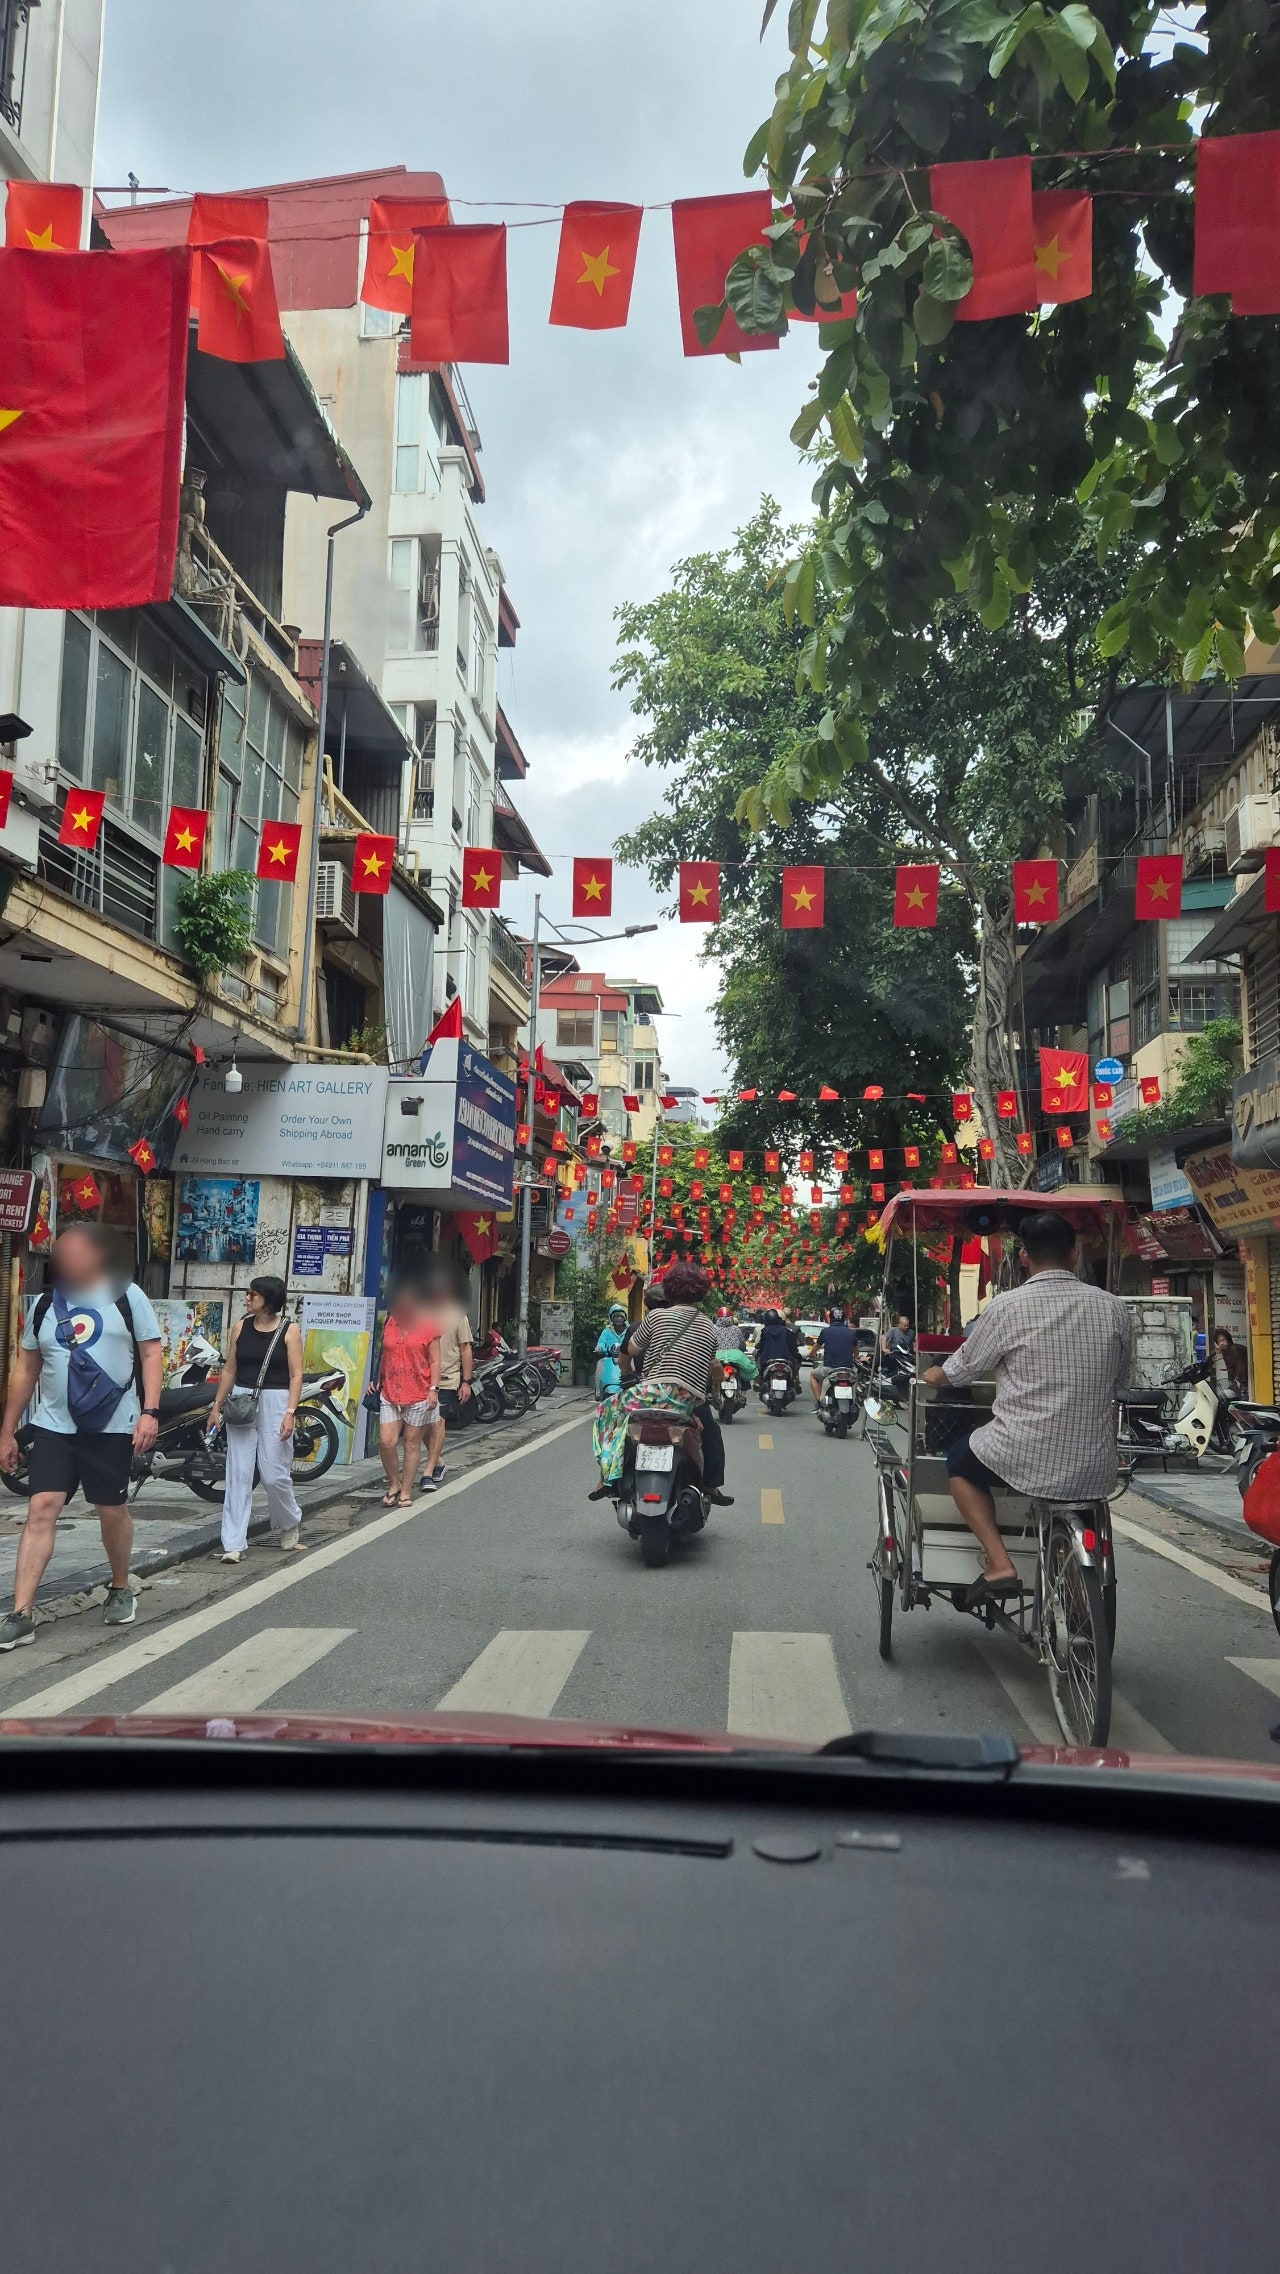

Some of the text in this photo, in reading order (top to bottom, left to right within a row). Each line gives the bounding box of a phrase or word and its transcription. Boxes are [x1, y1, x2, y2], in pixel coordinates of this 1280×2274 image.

[204, 1078, 372, 1094] Fane: HIEN ART GALLERY
[198, 1111, 249, 1124] Oil Painting
[280, 1114, 352, 1125] Order Your Own
[197, 1126, 245, 1138] Hand carry
[280, 1128, 353, 1140] Shipping Abroad
[387, 1144, 432, 1158] annam
[405, 1158, 426, 1168] Green
[6, 1204, 26, 1216] RENT
[324, 1211, 345, 1222] 29
[0, 1218, 24, 1228] TICKETS
